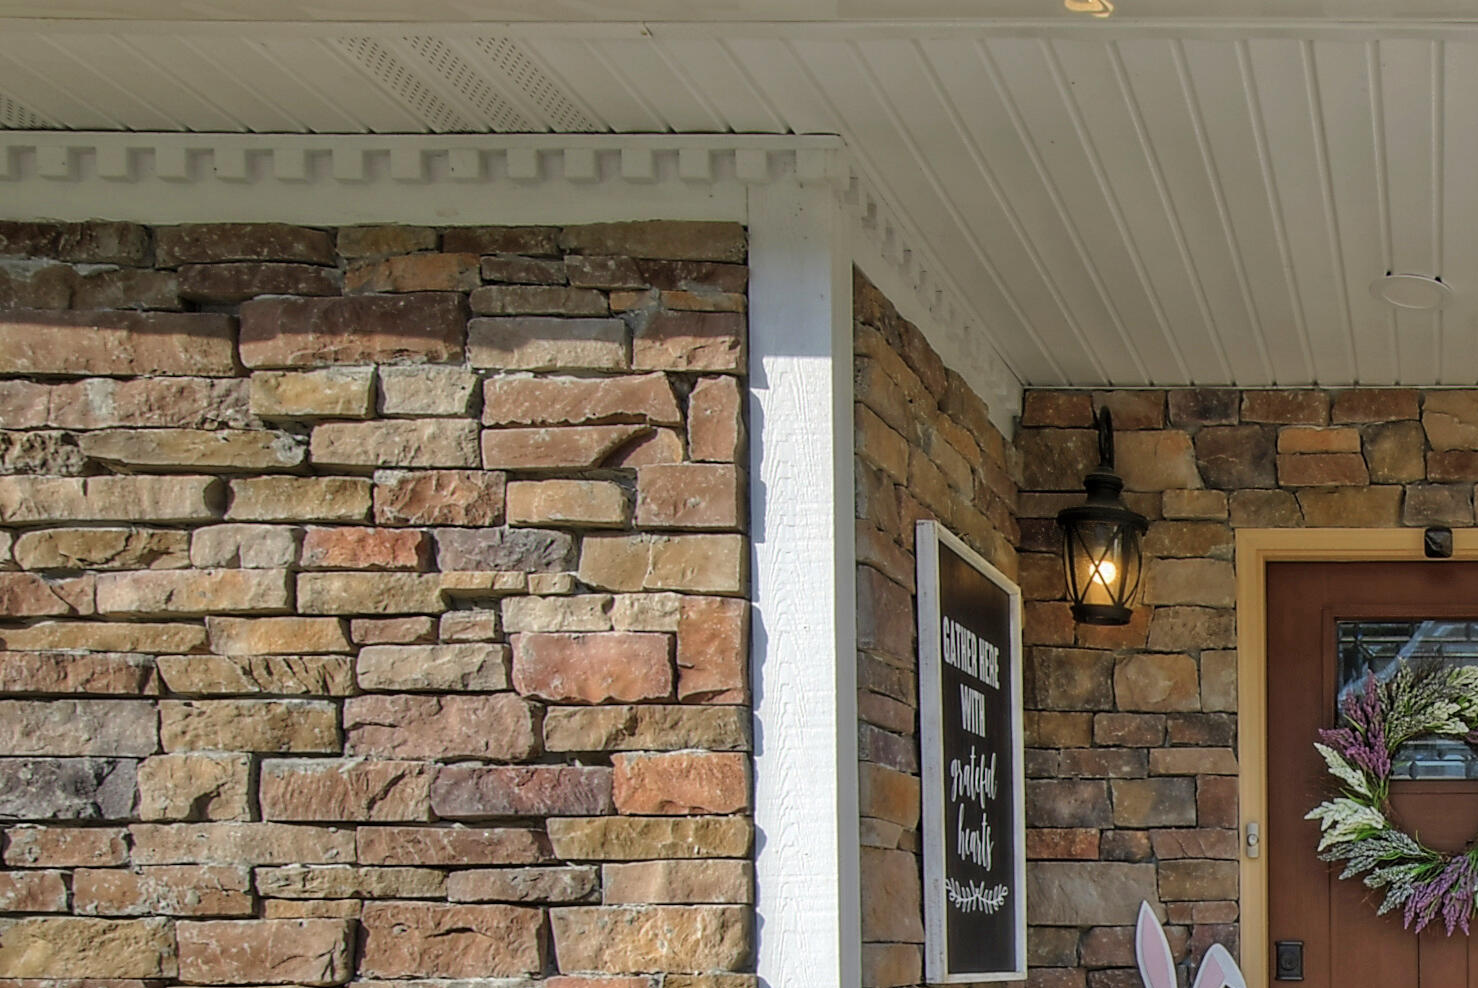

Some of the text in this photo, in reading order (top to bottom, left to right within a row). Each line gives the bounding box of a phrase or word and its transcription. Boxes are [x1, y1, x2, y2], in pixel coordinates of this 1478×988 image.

[943, 615, 1000, 691] GATHER HERE
[960, 683, 986, 738] WITH
[951, 745, 998, 809] grateful
[958, 803, 994, 872] hearts
